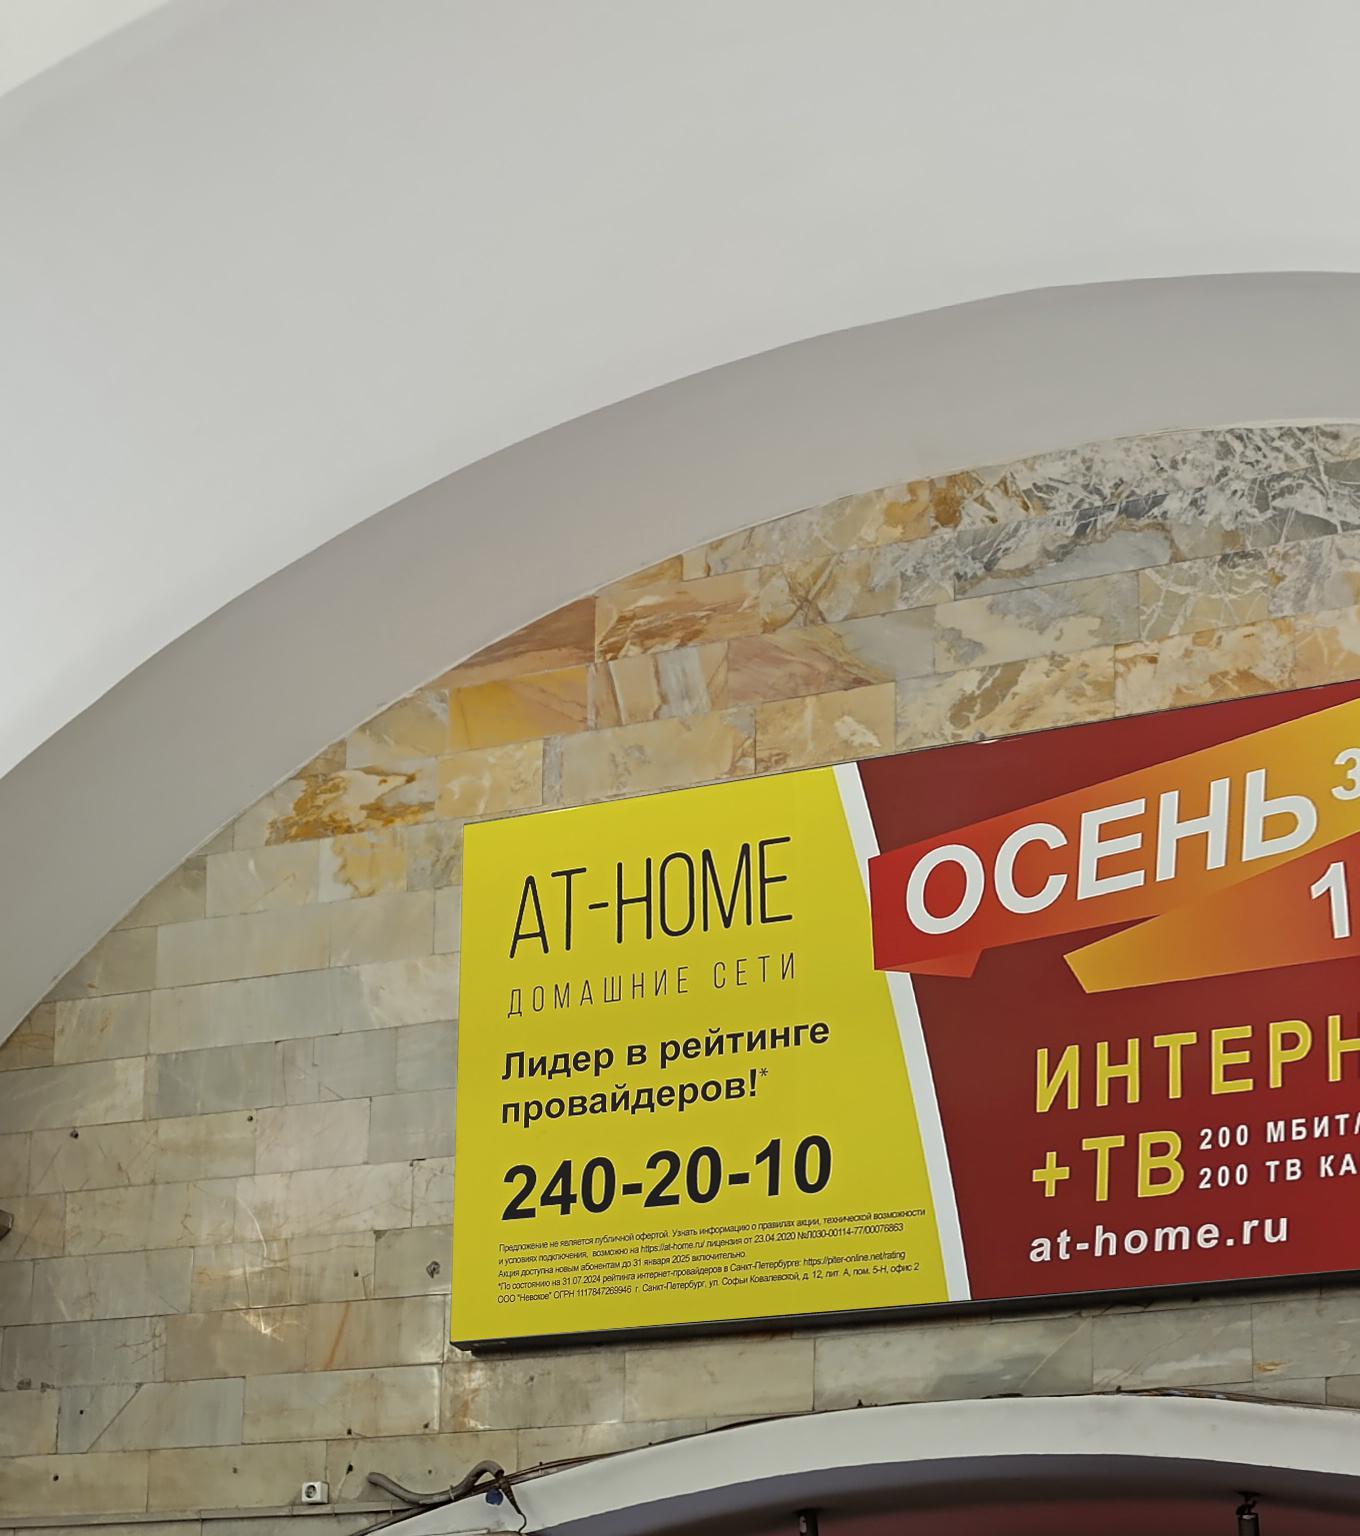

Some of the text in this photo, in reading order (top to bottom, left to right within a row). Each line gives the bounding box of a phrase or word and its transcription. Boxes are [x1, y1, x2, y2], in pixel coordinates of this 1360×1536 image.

[905, 768, 1319, 936] ОСЕНЬ
[509, 836, 793, 959] AT-HOME
[507, 952, 794, 1019] ДОМАШНИЕ СЕТИ
[502, 1023, 829, 1080] Лидер в рейтинге
[1200, 1125, 1248, 1150] 200
[501, 1135, 831, 1220] 240-20-10
[1032, 1131, 1184, 1202] +ТВ
[1199, 1164, 1248, 1189] 200
[1265, 1159, 1301, 1182] ТВ
[499, 1242, 548, 1253] Предложение
[560, 1238, 594, 1247] является
[594, 1233, 634, 1246] публичной
[672, 1229, 698, 1237] Узнать
[699, 1224, 750, 1235] информацию
[758, 1221, 795, 1231] правилах
[823, 1212, 872, 1224] технической
[873, 1209, 925, 1220] возможности
[505, 1256, 537, 1266] условиях
[592, 1248, 628, 1257] возможно
[706, 1238, 742, 1248] лицензия
[754, 1231, 796, 1243] 23.04.2020
[1030, 1218, 1287, 1262] at-home.ru
[498, 1270, 519, 1278] Акция
[520, 1267, 554, 1277] доступна
[555, 1265, 579, 1273] новым
[580, 1262, 620, 1271] абонентам
[621, 1261, 631, 1269] до
[633, 1258, 641, 1267] 31
[644, 1257, 670, 1266] января
[671, 1254, 690, 1264] 2025
[512, 1280, 550, 1290] состоянию
[562, 1275, 601, 1285] 31.07.2024
[602, 1273, 635, 1284] рейтинга
[637, 1266, 722, 1279] интернет-провайдеров
